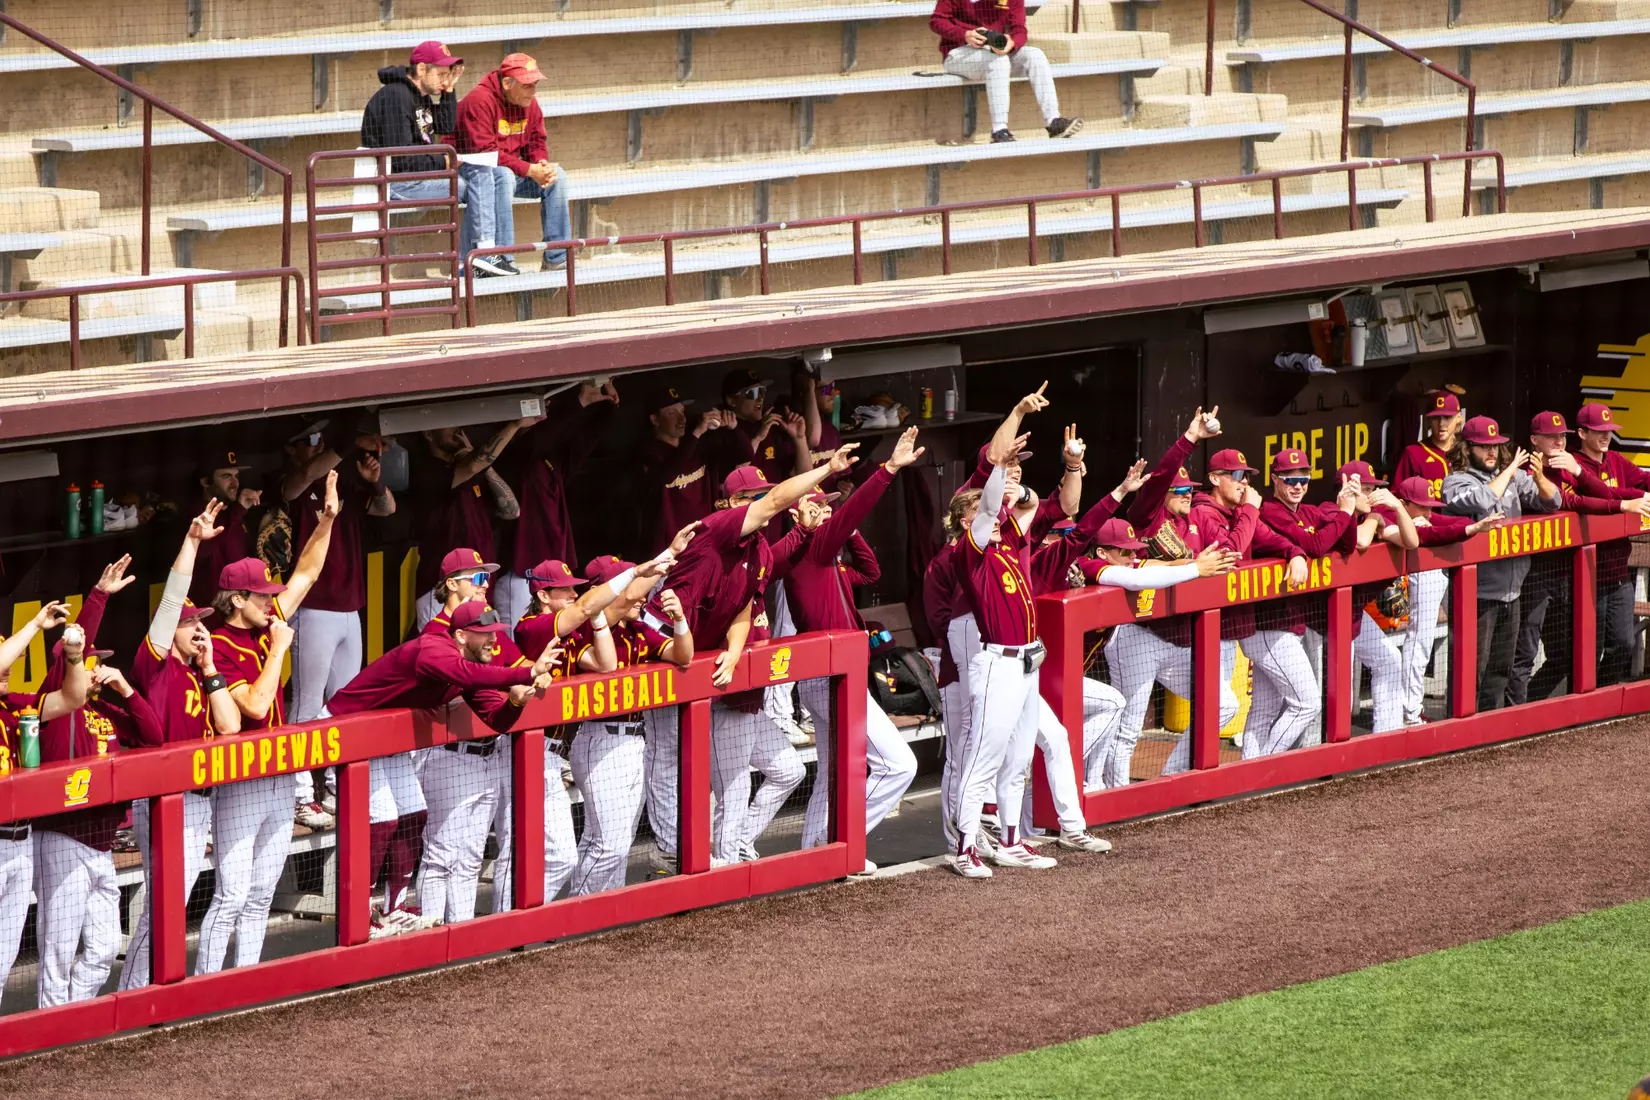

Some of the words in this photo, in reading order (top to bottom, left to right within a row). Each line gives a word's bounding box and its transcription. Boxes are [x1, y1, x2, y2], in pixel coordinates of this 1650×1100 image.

[1436, 397, 1445, 408] C
[1552, 415, 1561, 427] C
[1602, 410, 1610, 421] C
[1487, 425, 1496, 437] C
[1336, 422, 1369, 470] UP
[227, 451, 236, 464] C
[1237, 453, 1246, 464] C
[1290, 453, 1300, 464] C
[1178, 467, 1187, 479] C
[1368, 464, 1375, 477] C
[1427, 486, 1434, 498] C
[1126, 526, 1135, 539] C
[1489, 516, 1572, 558] BASEBALL
[472, 551, 482, 564] C
[264, 567, 271, 582] C
[561, 563, 571, 576] C
[1002, 571, 1017, 594] 9
[1227, 556, 1332, 602] CHIPPAS
[562, 669, 677, 721] BASEBALL
[193, 727, 340, 785] CHIPPEWAS
